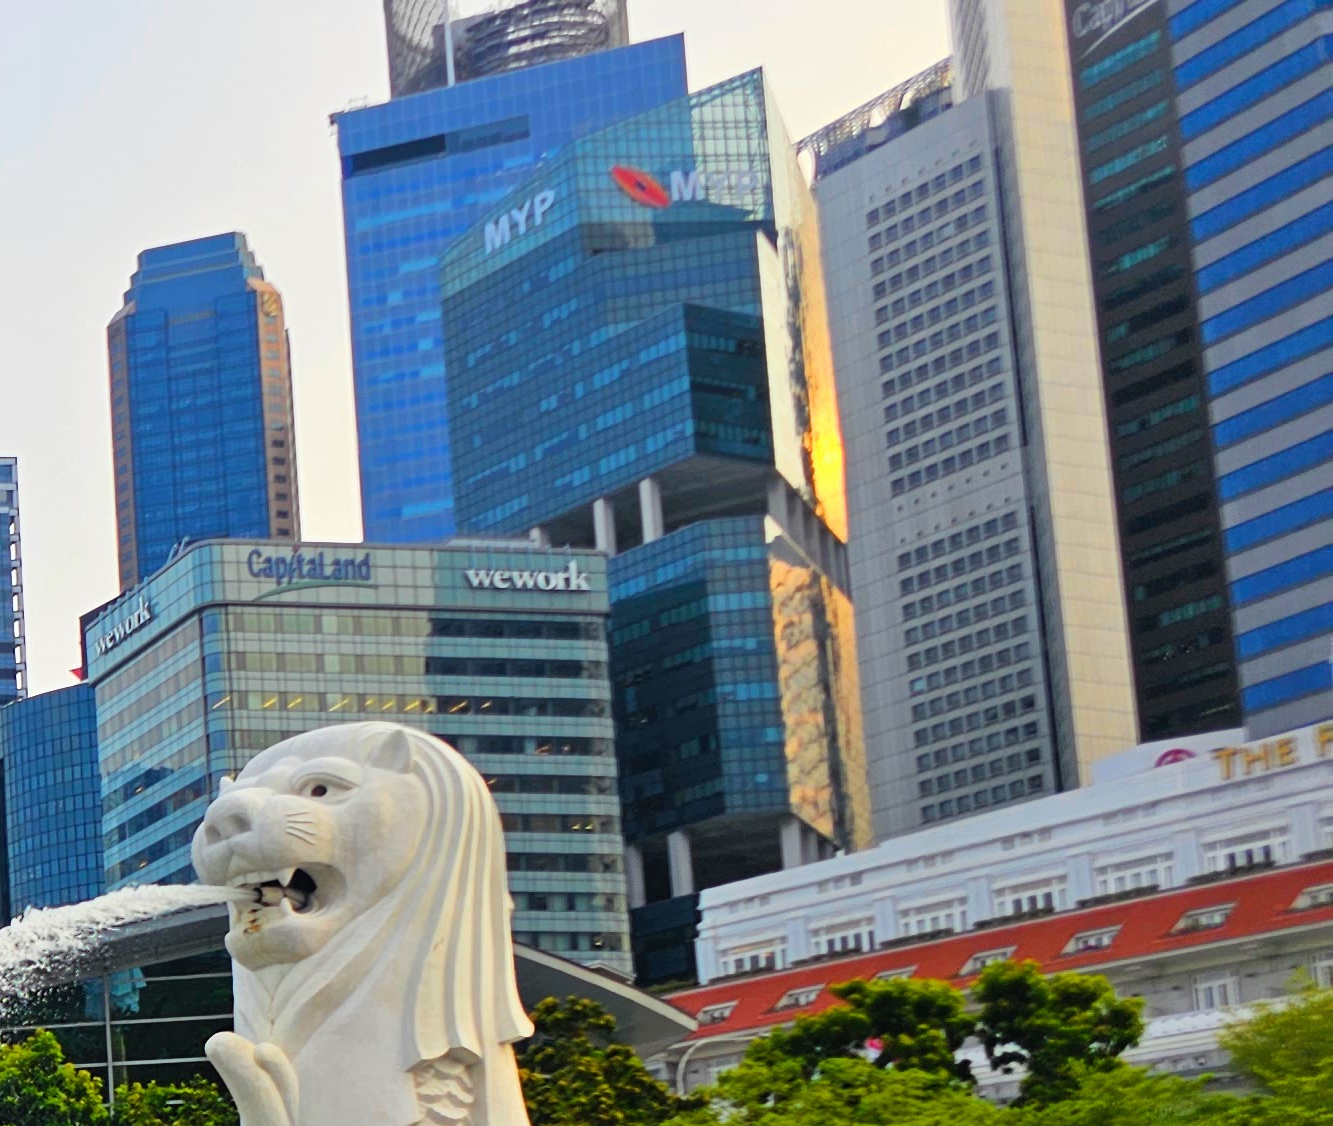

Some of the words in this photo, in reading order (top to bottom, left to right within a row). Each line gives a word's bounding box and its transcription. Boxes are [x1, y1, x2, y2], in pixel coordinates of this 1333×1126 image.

[670, 169, 759, 201] MYP
[484, 189, 555, 255] MYP
[247, 545, 371, 585] CapitaLand
[464, 559, 592, 592] wework
[93, 597, 151, 656] wework
[1211, 736, 1298, 781] THE
